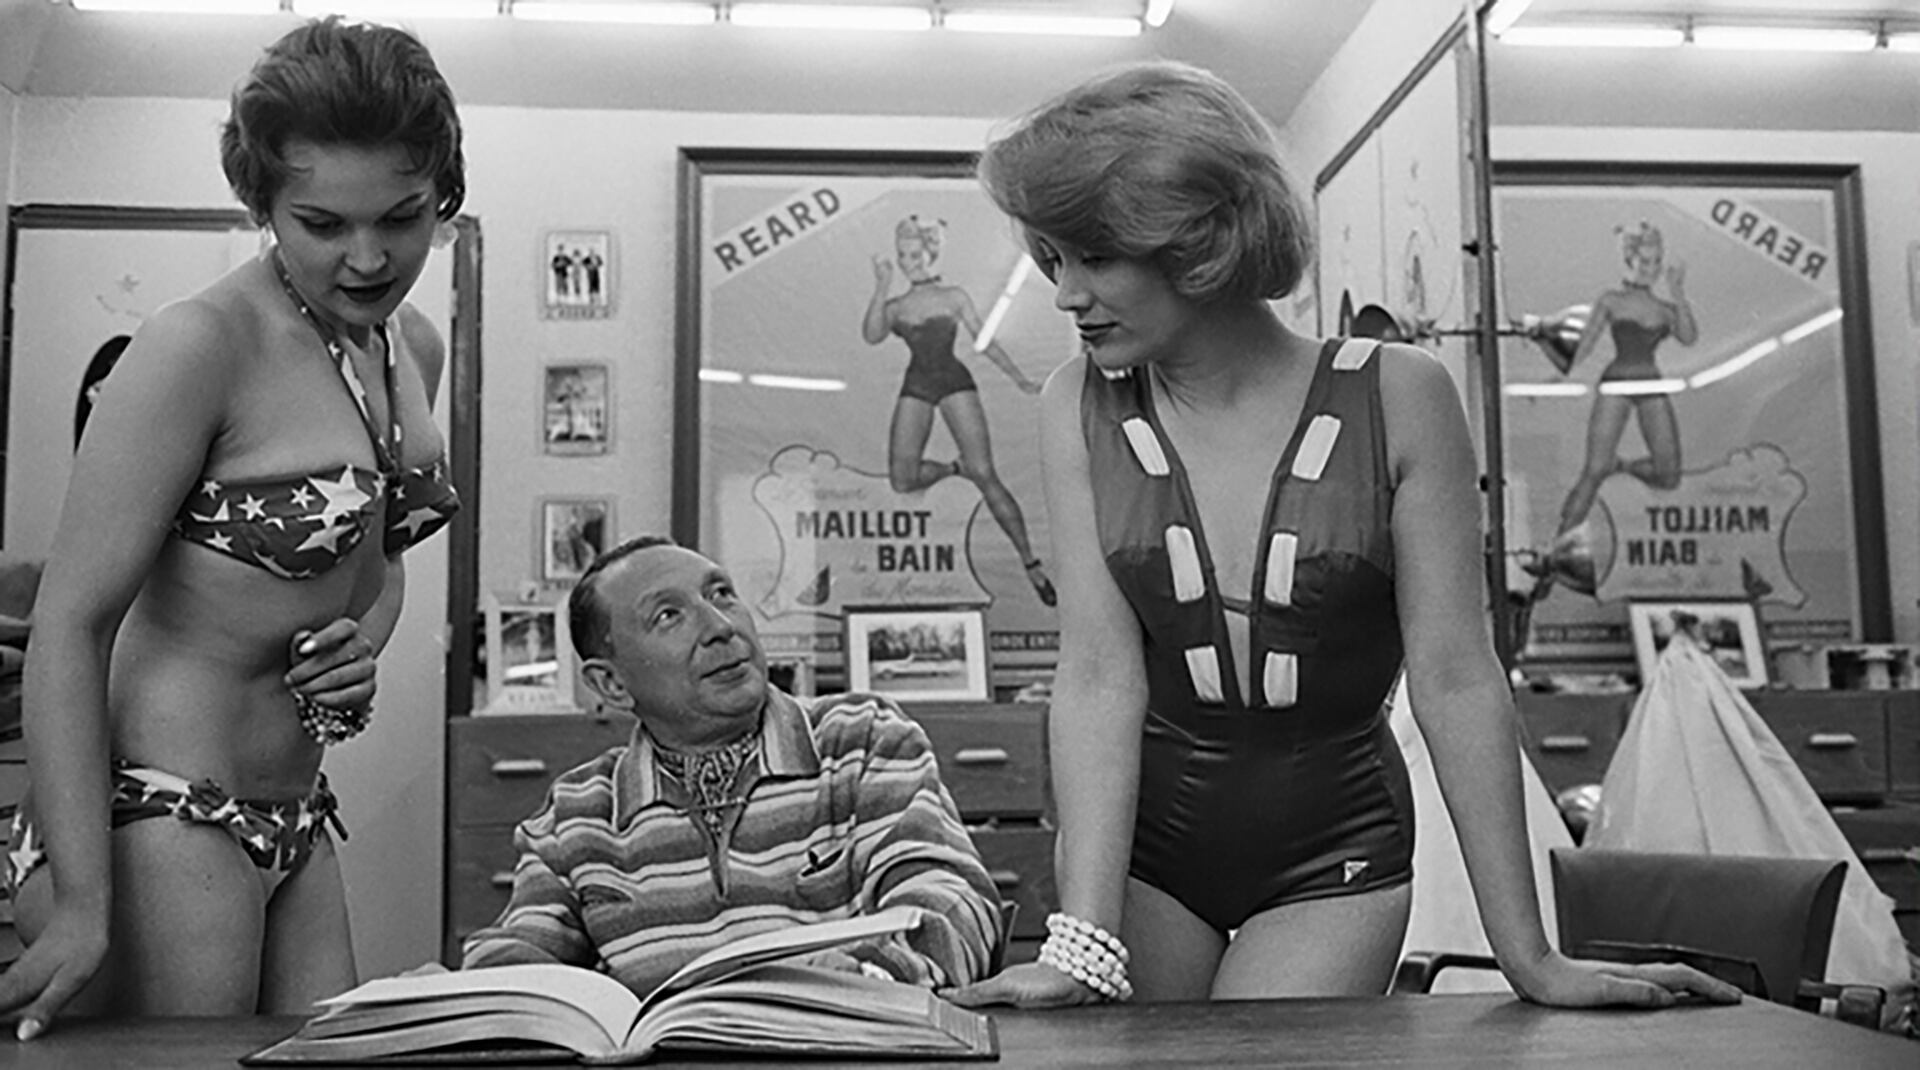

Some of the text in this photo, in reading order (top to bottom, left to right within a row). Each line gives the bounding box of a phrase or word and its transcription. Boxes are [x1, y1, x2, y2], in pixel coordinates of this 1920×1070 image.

[714, 187, 841, 272] REARD
[795, 511, 932, 539] MAILLOT
[877, 544, 955, 572] BAIN
